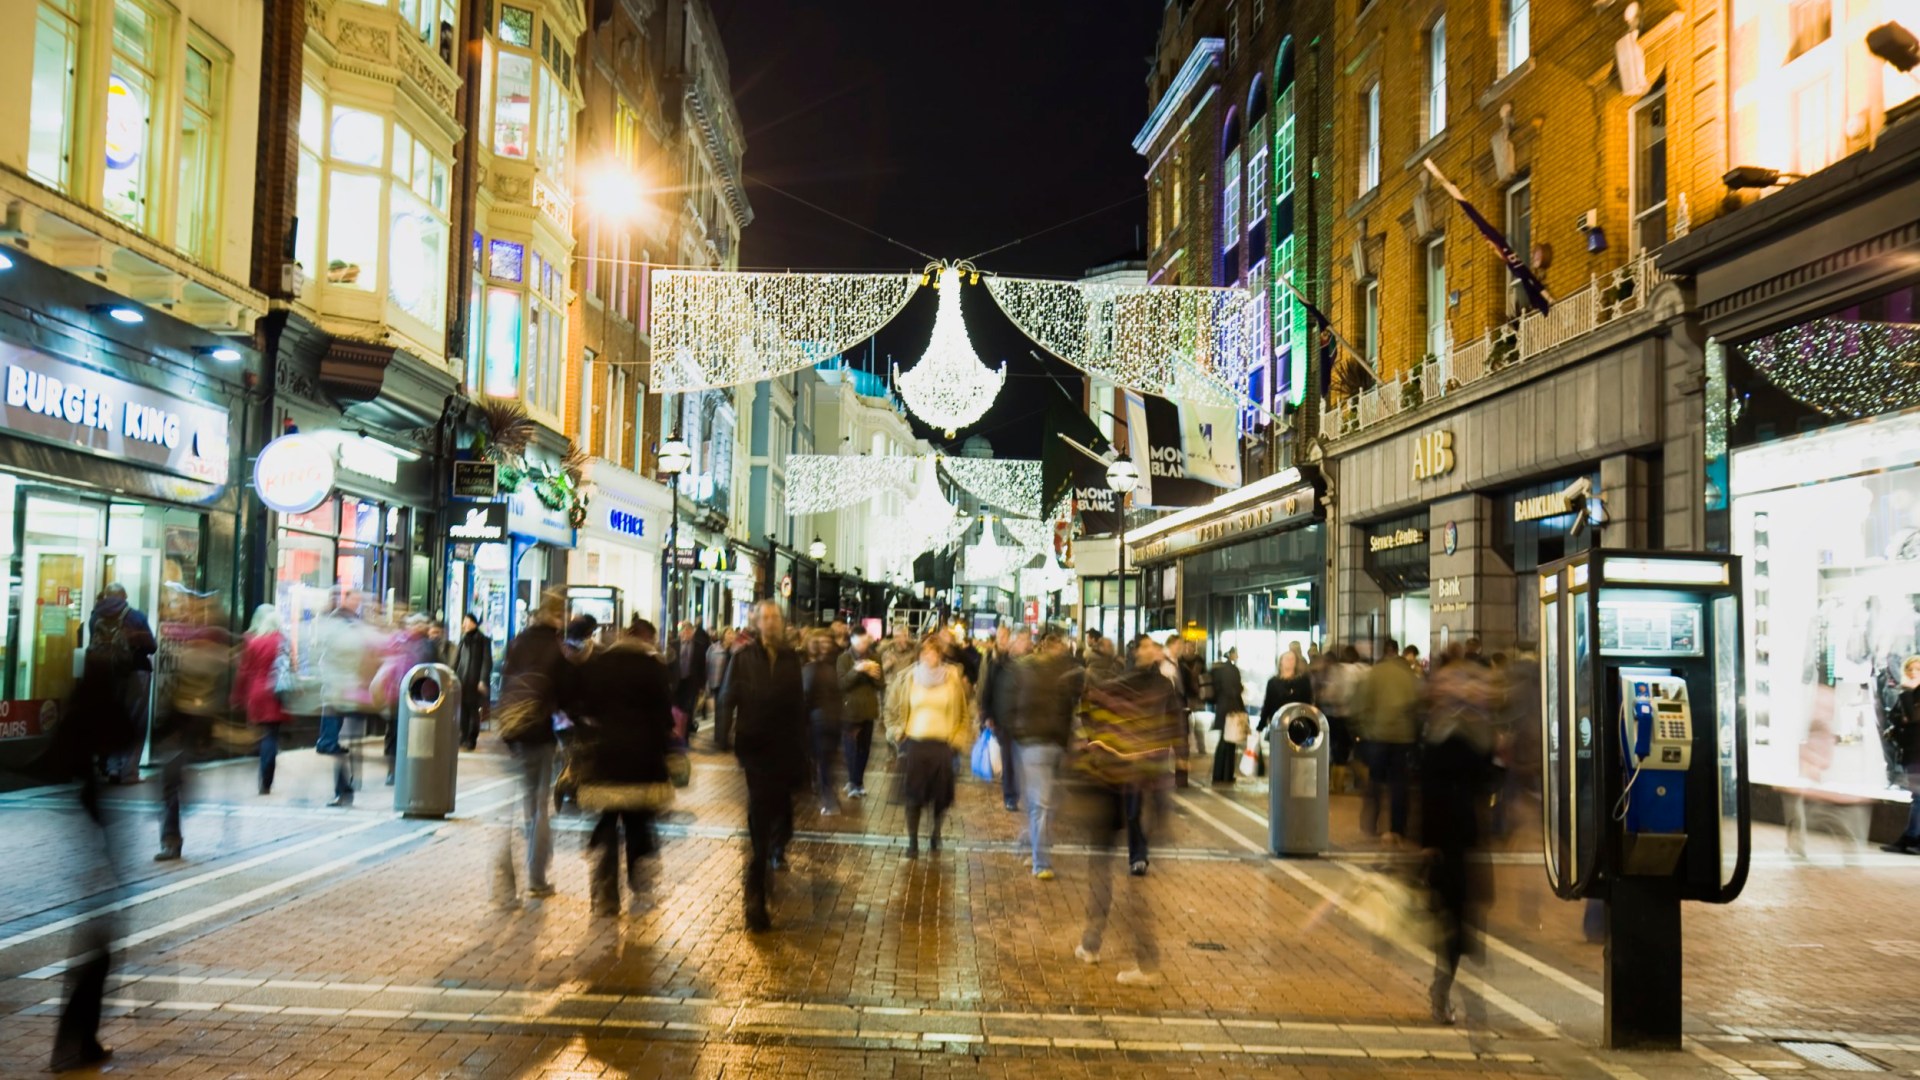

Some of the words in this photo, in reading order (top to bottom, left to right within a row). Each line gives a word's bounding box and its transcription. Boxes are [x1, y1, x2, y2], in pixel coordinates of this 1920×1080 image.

[7, 365, 114, 431] BURGER
[123, 401, 181, 449] KING
[1150, 446, 1184, 463] MON
[1412, 430, 1453, 480] AIB
[1151, 461, 1186, 479] BLAN
[1075, 487, 1113, 501] MONT
[1077, 499, 1115, 512] BLANC
[1515, 492, 1570, 522] BANKLINK
[610, 509, 645, 537] OFFICE
[1197, 521, 1224, 542] WEIR
[1239, 507, 1272, 531] SONS
[669, 547, 693, 556] HALTH
[1370, 535, 1393, 552] Service
[1438, 575, 1461, 597] Bank
